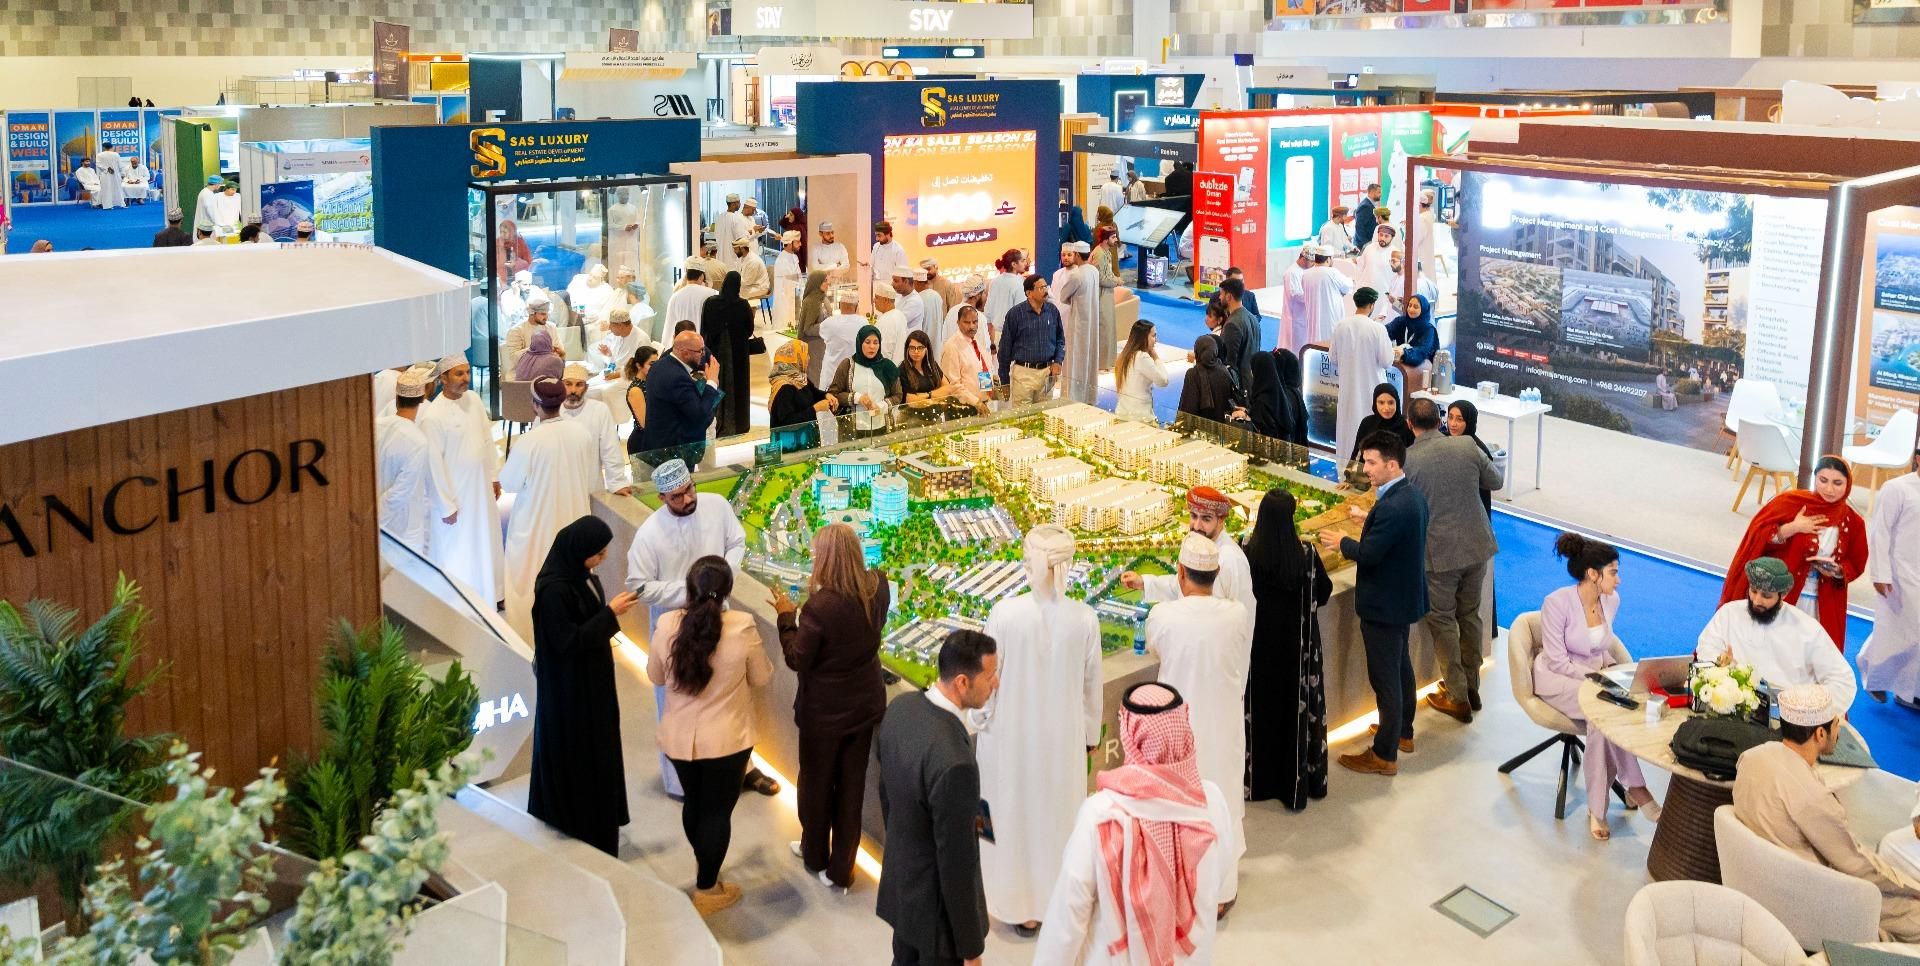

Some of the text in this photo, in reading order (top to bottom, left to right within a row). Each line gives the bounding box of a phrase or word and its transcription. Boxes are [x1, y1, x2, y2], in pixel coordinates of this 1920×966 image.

[757, 7, 783, 29] STAY
[909, 9, 954, 31] STAY
[947, 93, 1000, 103] SAS LUXURY
[105, 121, 136, 129] OMAN
[10, 132, 48, 140] DESIGN
[102, 130, 139, 138] DESIGN
[510, 134, 589, 147] SAS LUXURY
[927, 135, 961, 146] SALE
[967, 133, 1020, 144] SEASON
[111, 137, 138, 145] BUILD
[11, 148, 48, 157] WEEK
[1200, 177, 1228, 191] dubizzle
[1206, 190, 1222, 198] Oman
[1511, 215, 1536, 226] Project
[1537, 217, 1583, 231] Management
[1584, 222, 1598, 232] and
[1600, 224, 1617, 234] Cost
[1619, 226, 1669, 241] Management
[1480, 244, 1542, 259] Project Management
[1475, 356, 1519, 371] majaneng.com
[1526, 365, 1588, 385] info@majaneng.com
[1596, 381, 1613, 391] +968
[0, 438, 329, 557] ANCHOR
